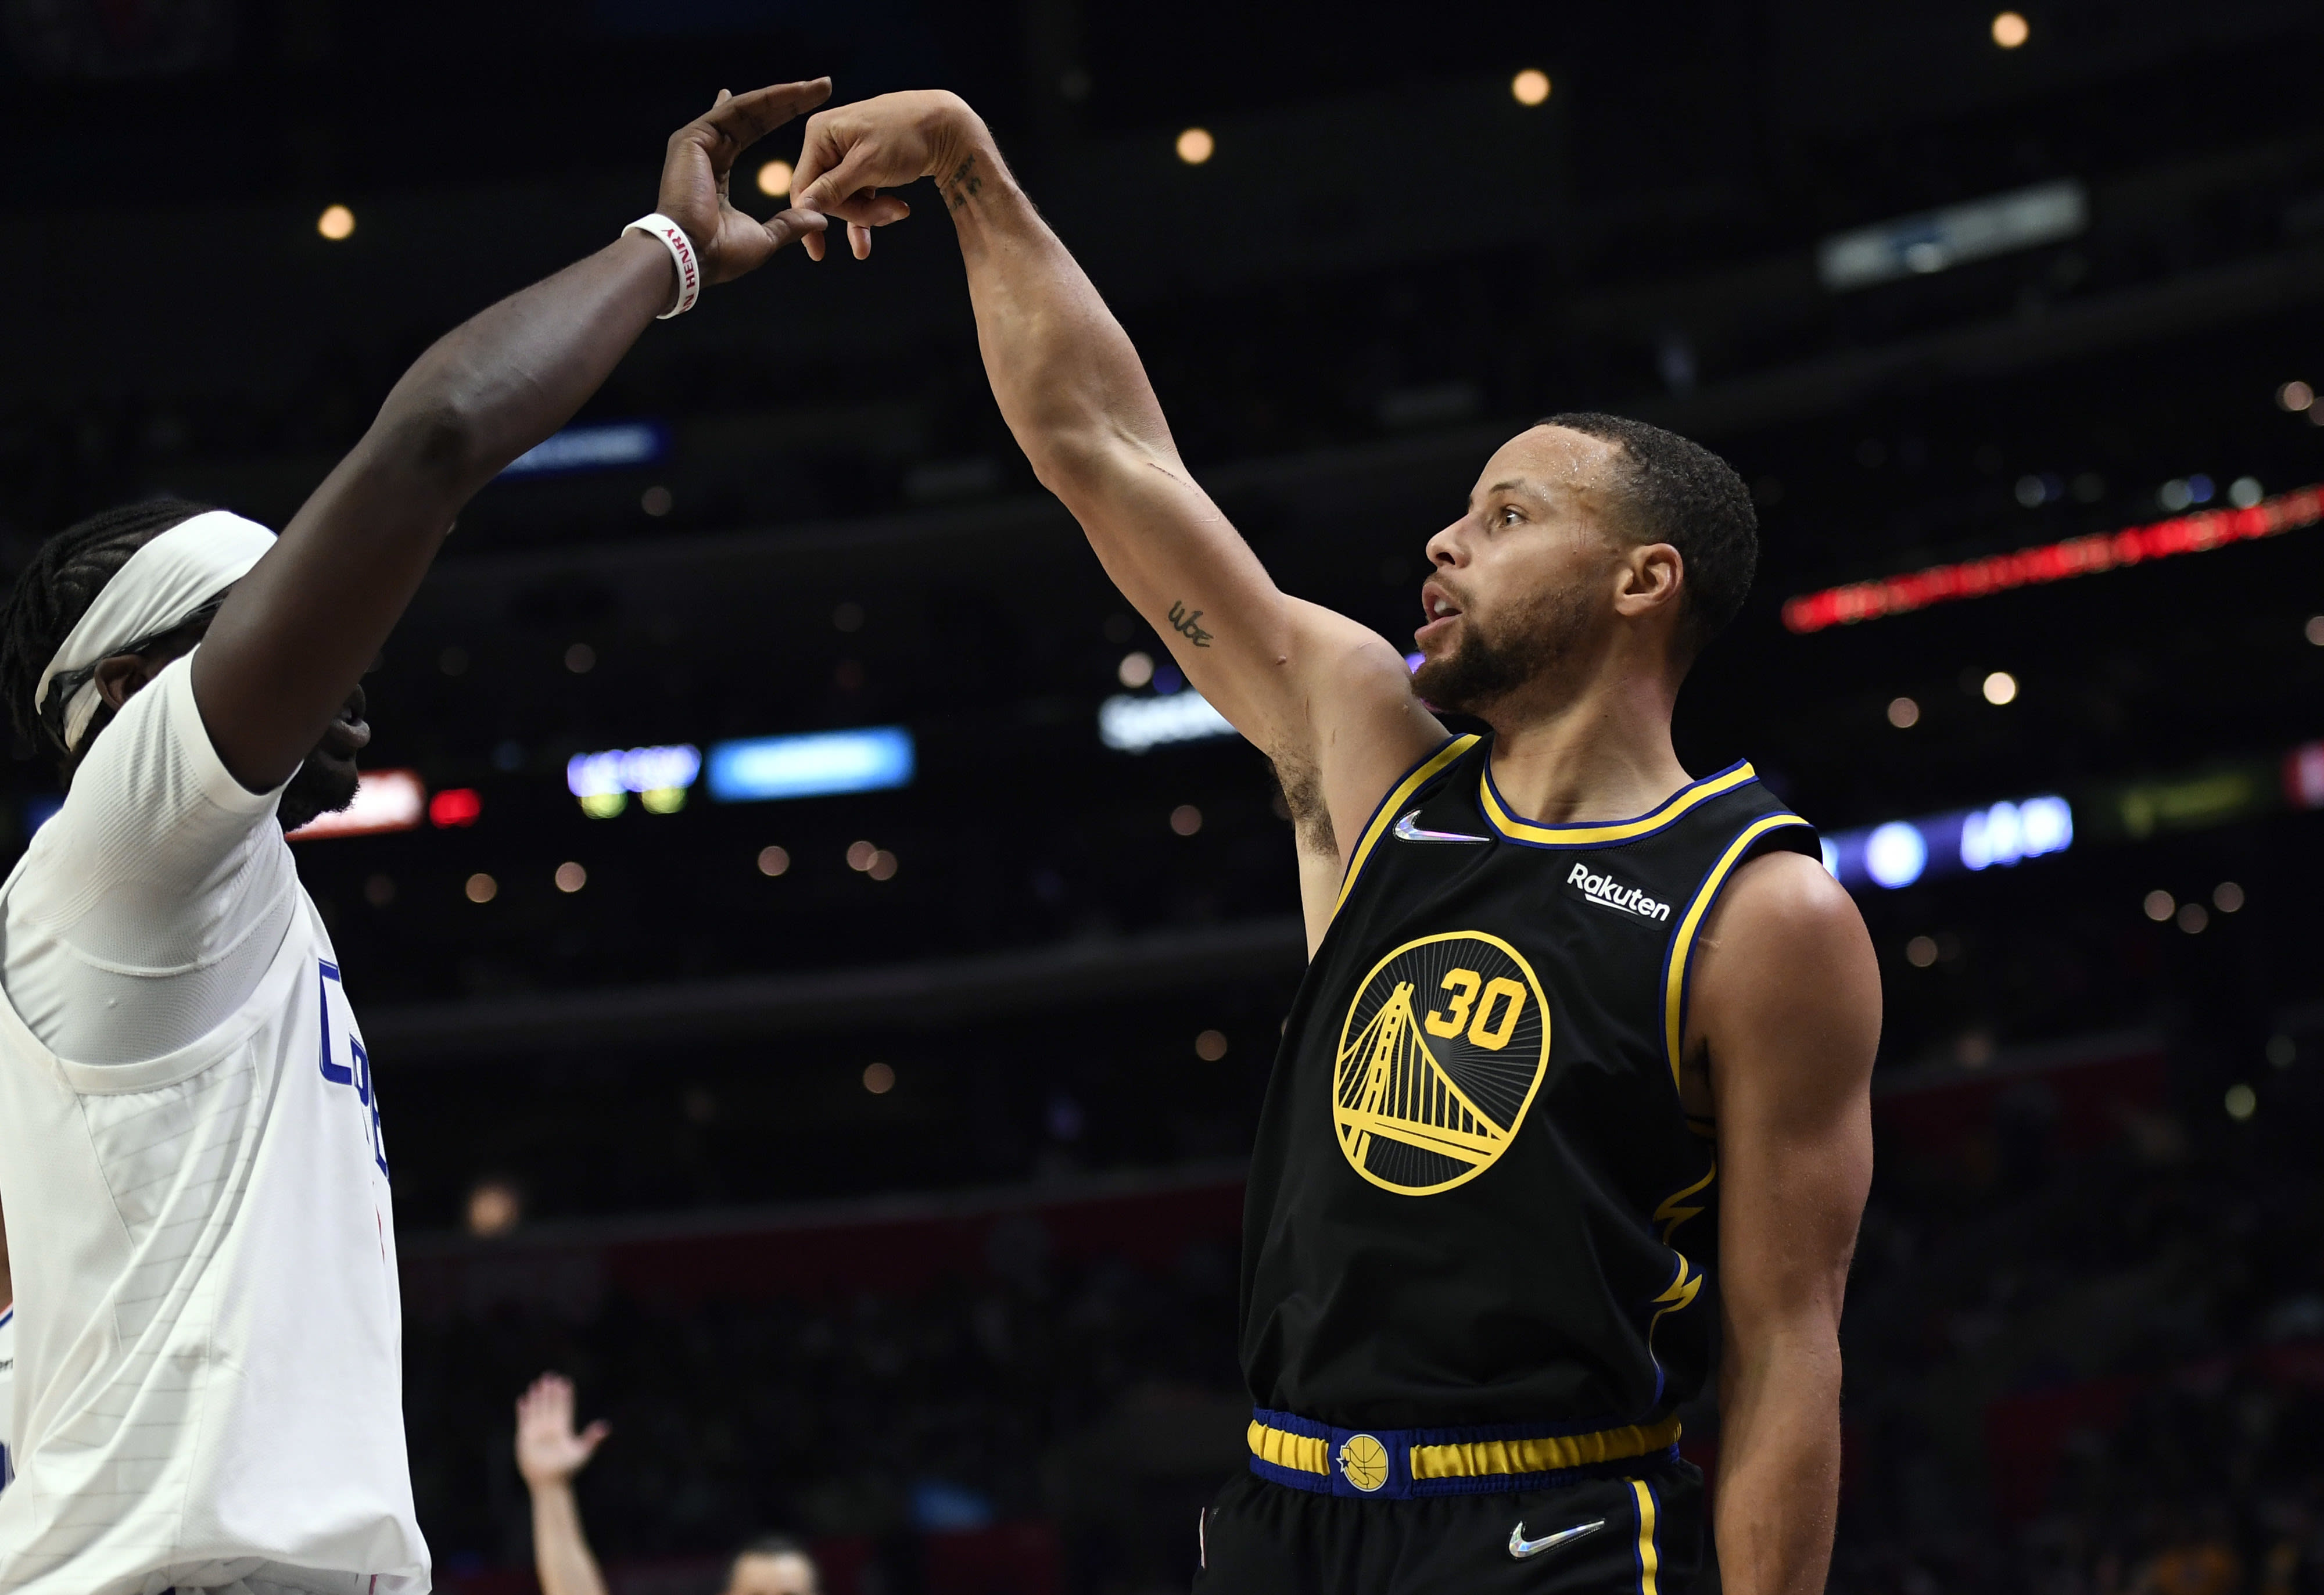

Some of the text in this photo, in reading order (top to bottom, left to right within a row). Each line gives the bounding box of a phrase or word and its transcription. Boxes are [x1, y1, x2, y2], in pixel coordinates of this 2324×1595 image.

[661, 228, 695, 289] HENRY
[1567, 862, 1671, 922] Rakuten
[1424, 967, 1527, 1051] 30
